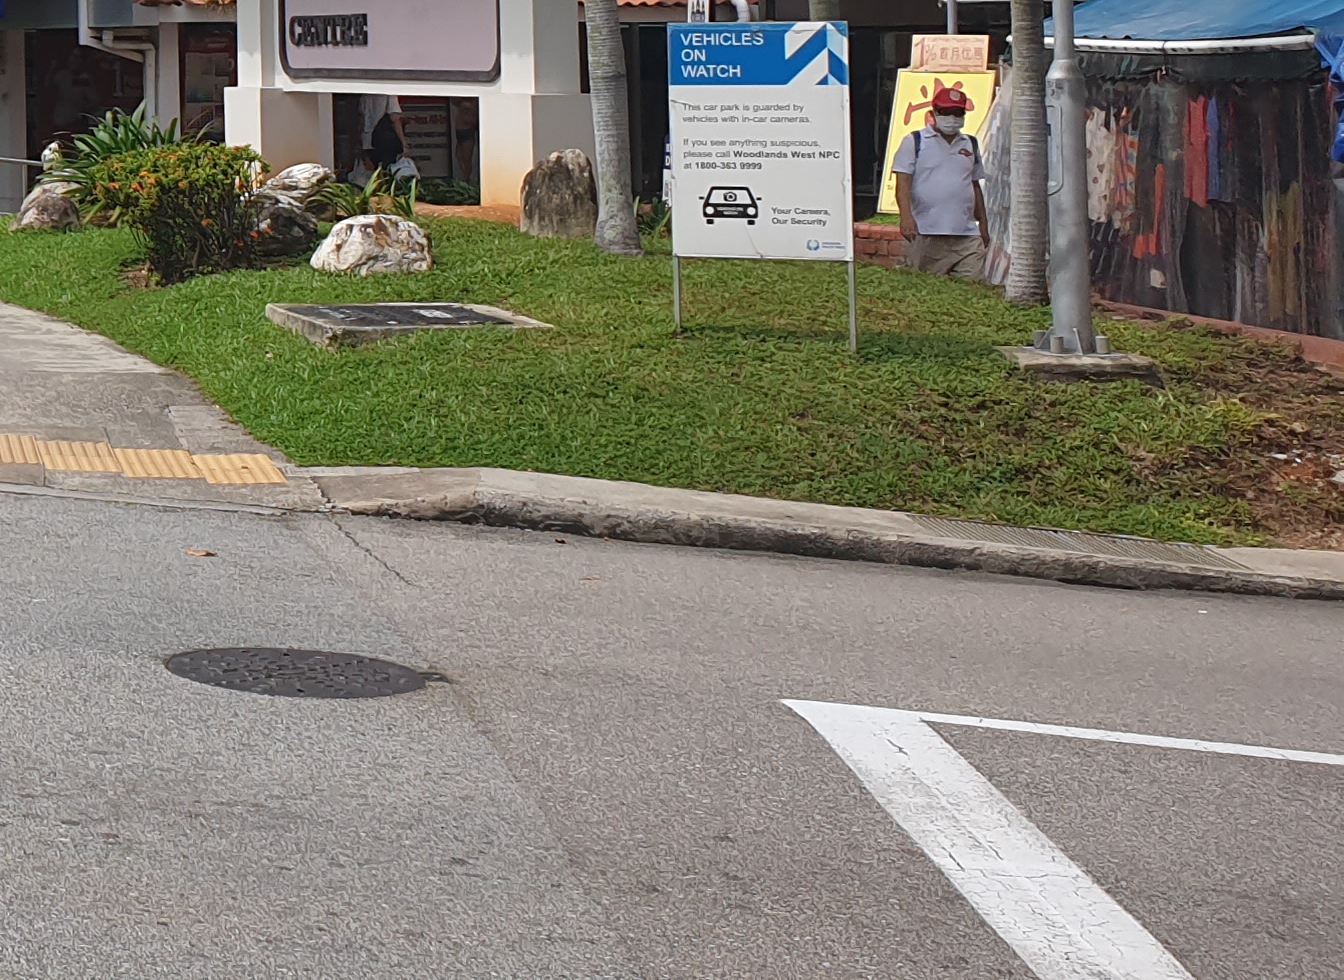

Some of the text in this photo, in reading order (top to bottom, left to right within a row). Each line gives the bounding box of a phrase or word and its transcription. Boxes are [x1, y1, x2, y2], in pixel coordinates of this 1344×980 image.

[289, 13, 369, 47] CENTRE
[680, 32, 764, 46] VEHICLES
[681, 49, 706, 62] ON
[681, 65, 741, 78] WATCH
[720, 104, 740, 112] park
[753, 104, 790, 112] guarded
[793, 104, 804, 113] by
[729, 139, 767, 148] anything
[683, 150, 712, 158] please
[733, 150, 788, 158] Woodlands
[819, 151, 840, 159] NPC
[771, 207, 792, 215] Your
[772, 217, 827, 227] Our Security
